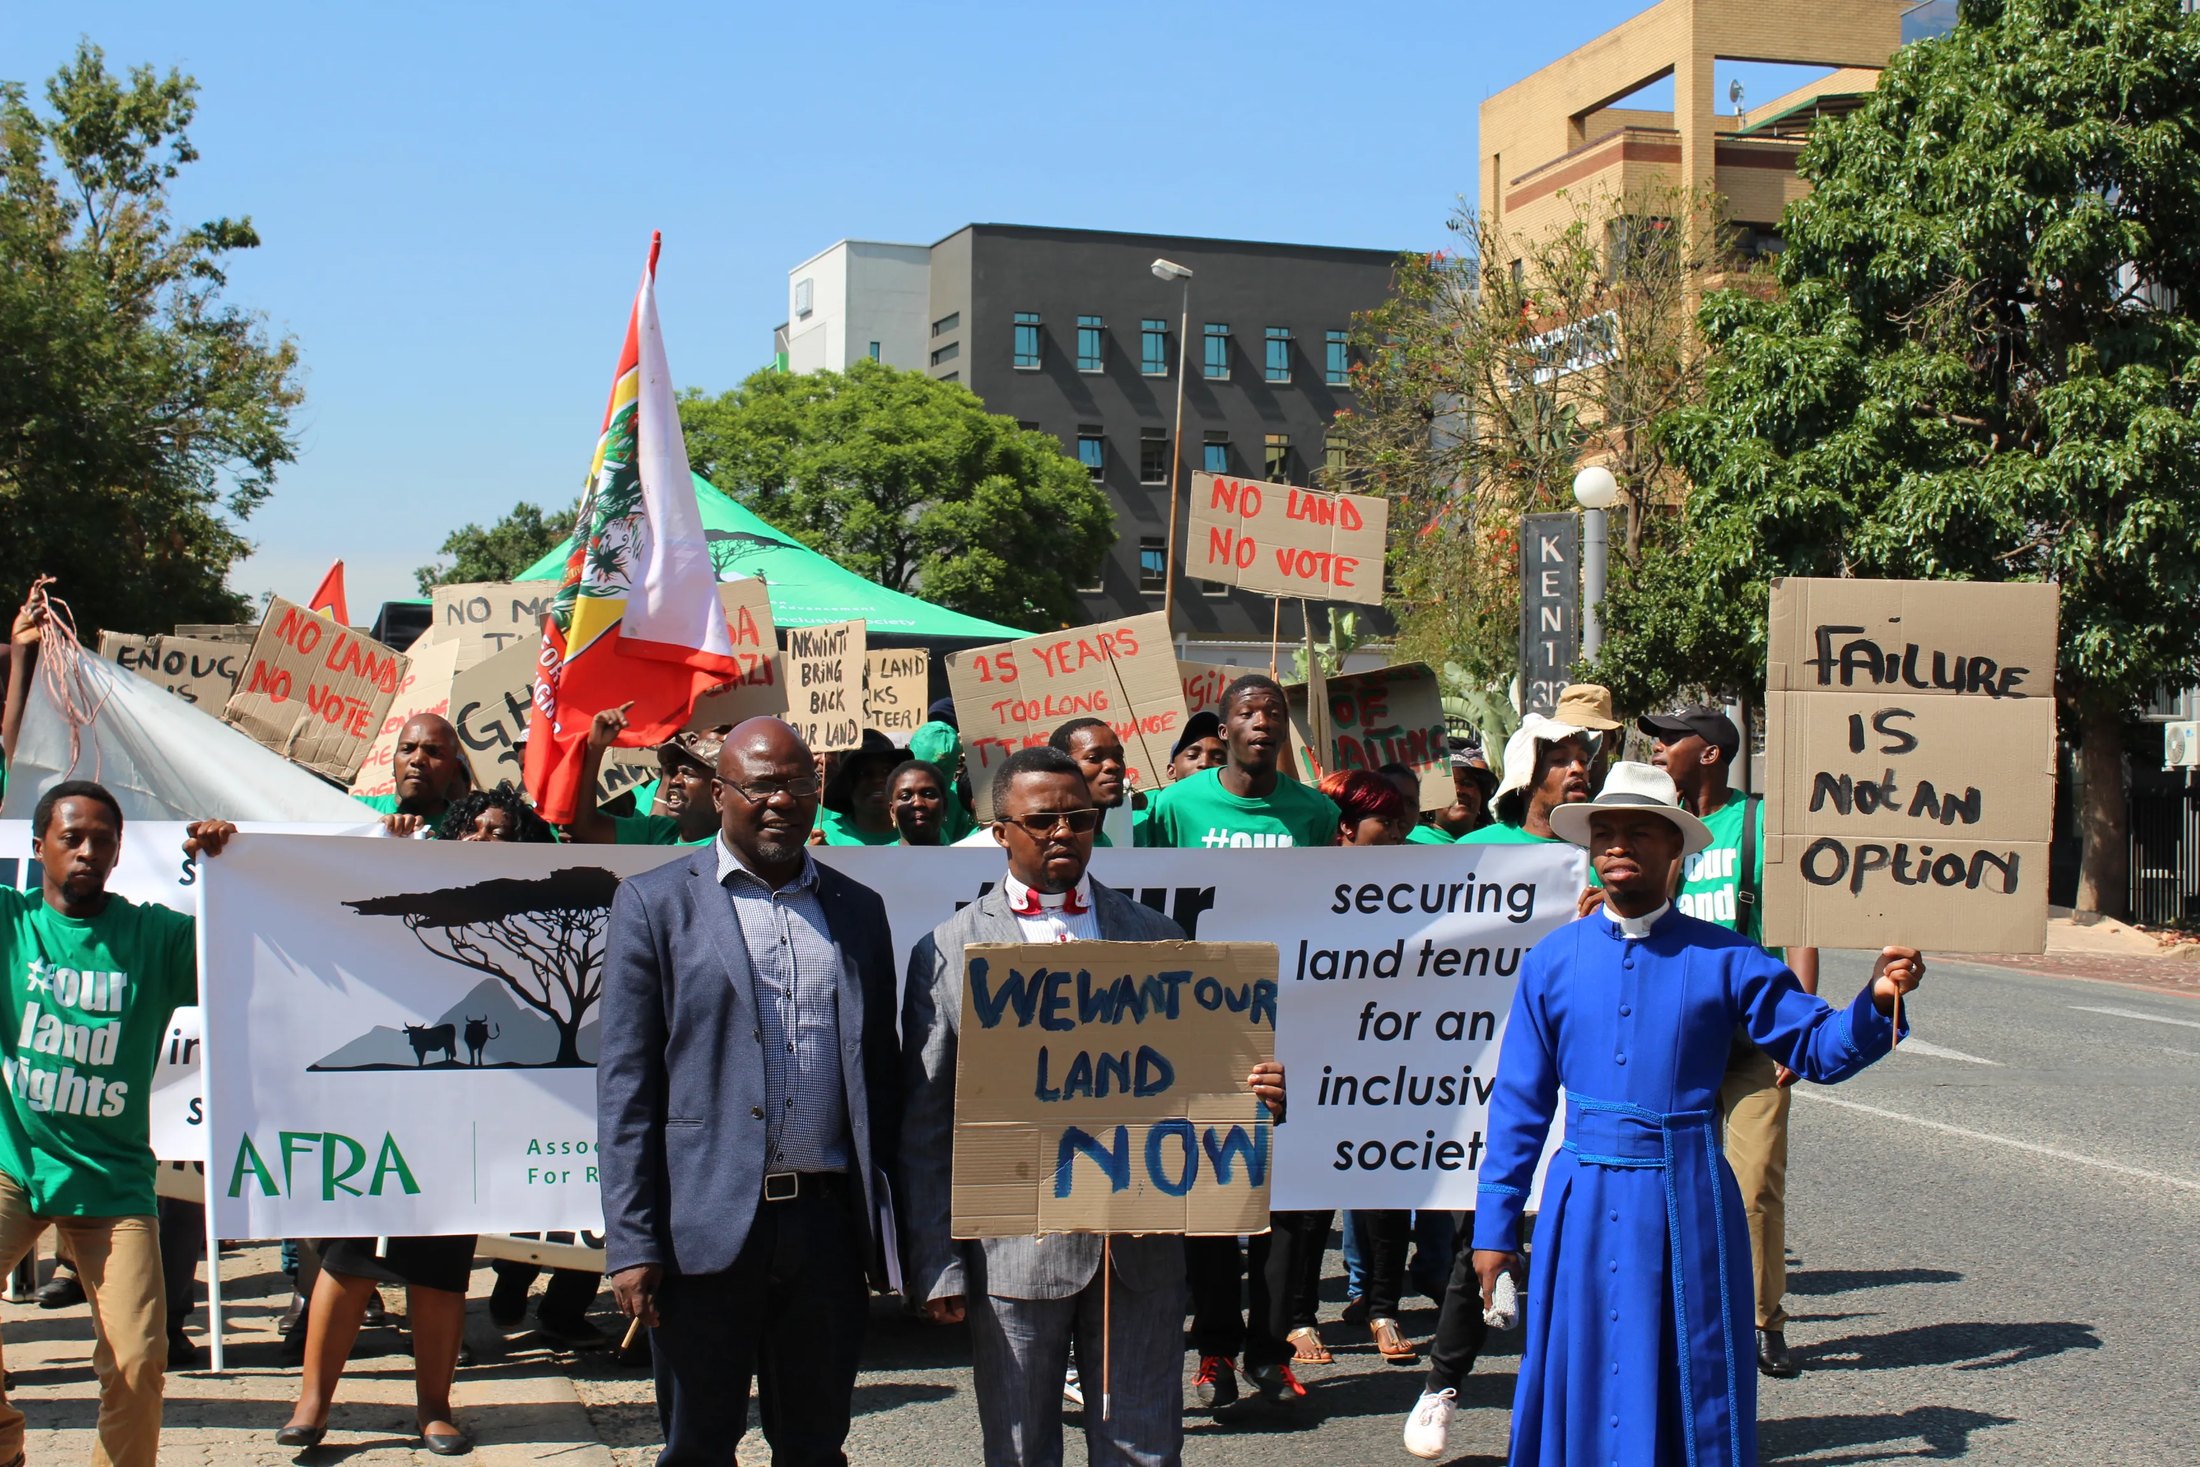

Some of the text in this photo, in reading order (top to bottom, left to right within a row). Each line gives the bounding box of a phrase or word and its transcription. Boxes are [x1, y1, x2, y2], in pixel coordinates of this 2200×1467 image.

[1211, 477, 1363, 531] NO LAND
[1208, 527, 1360, 587] NO VOTE
[447, 596, 492, 626] NO
[276, 608, 399, 694] NO LAND
[880, 655, 925, 679] LAND
[973, 628, 1139, 684] 15 YEARS
[248, 660, 292, 703] NO
[308, 684, 374, 739] VOTE
[810, 687, 846, 714] BACK
[825, 718, 859, 747] LAND
[1848, 706, 1919, 755] IS
[1907, 779, 1981, 826] AN
[1331, 873, 1537, 924] securing
[26, 955, 128, 1012] #our
[1297, 939, 1532, 981] land tenu
[17, 1001, 122, 1066] land
[1358, 1002, 1496, 1041] for an
[3, 1056, 129, 1118] rights
[1035, 1045, 1175, 1102] LAND
[227, 1130, 422, 1201] AFRA
[1053, 1100, 1273, 1199] NOW
[1332, 1129, 1487, 1171] societ
[528, 1168, 571, 1184] For
